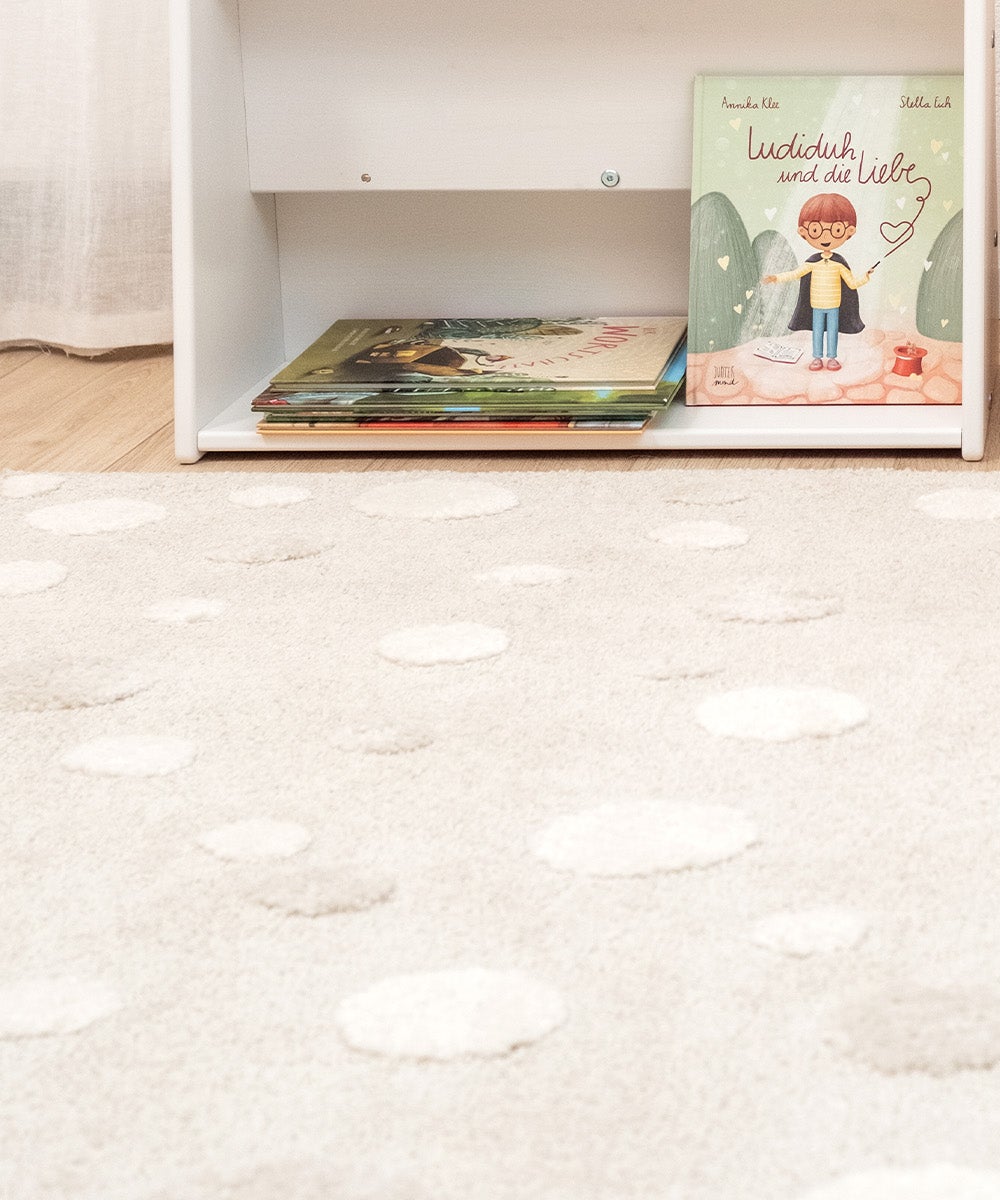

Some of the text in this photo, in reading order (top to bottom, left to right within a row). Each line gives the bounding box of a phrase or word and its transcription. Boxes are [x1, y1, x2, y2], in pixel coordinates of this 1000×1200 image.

[721, 95, 779, 109] Annika Klee
[899, 95, 931, 108] Stella
[748, 125, 857, 161] Ludiduh
[776, 149, 920, 185] und die Liebe
